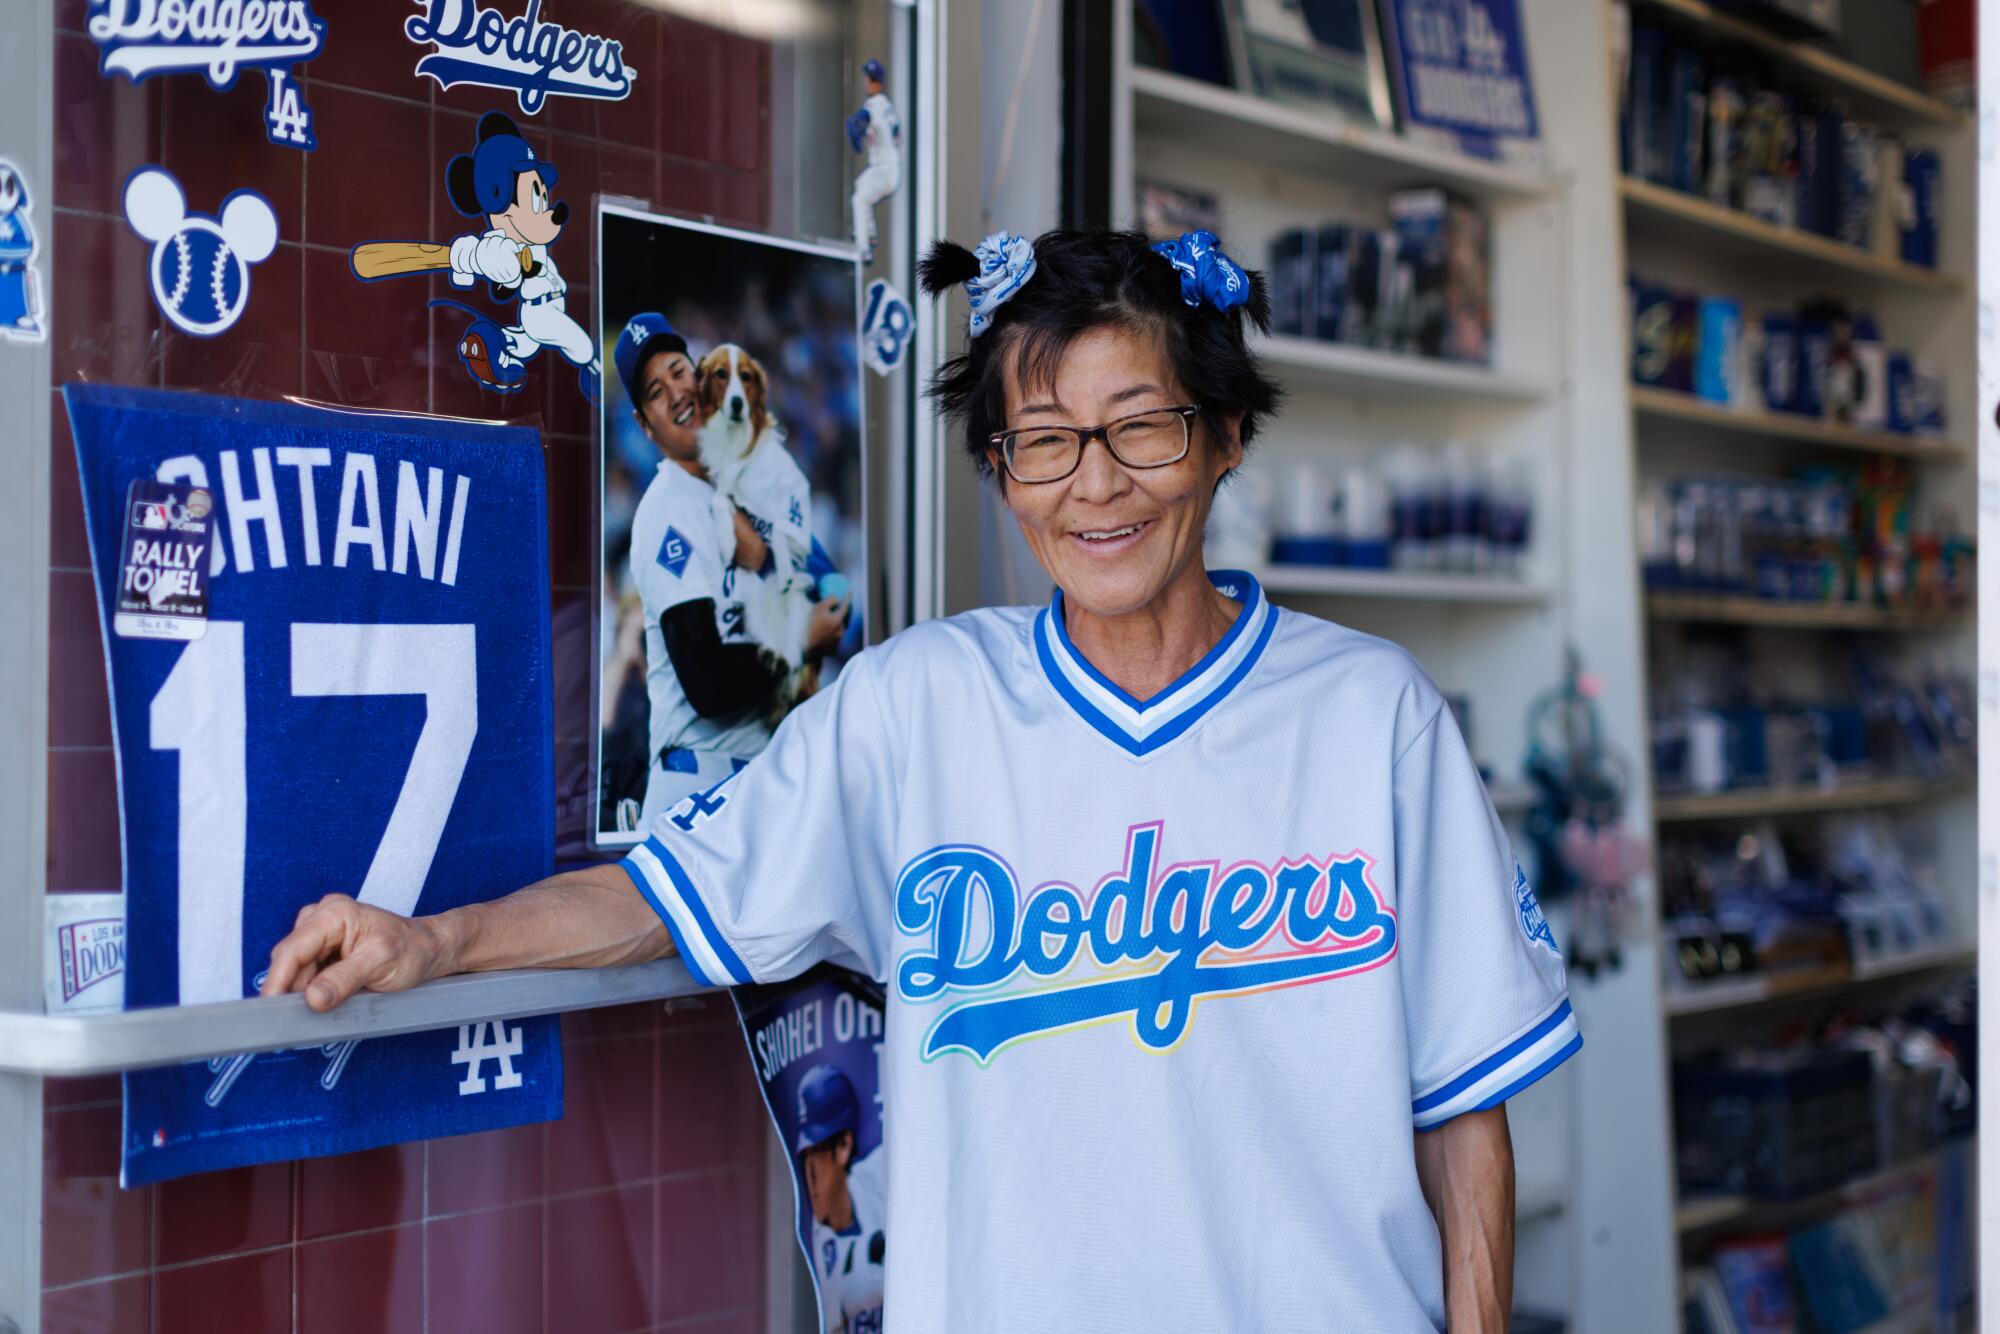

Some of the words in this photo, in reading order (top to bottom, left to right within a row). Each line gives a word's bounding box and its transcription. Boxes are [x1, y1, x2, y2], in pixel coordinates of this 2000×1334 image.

[406, 0, 630, 113] Dodgers
[269, 68, 308, 143] LA
[625, 322, 650, 346] LA
[124, 565, 201, 597] TOWEL
[130, 539, 204, 569] RALLY
[665, 538, 683, 557] G
[150, 620, 478, 1005] 17
[895, 819, 1398, 1068] Dodgers
[451, 1020, 523, 1096] LA
[756, 999, 824, 1083] SHOHEI
